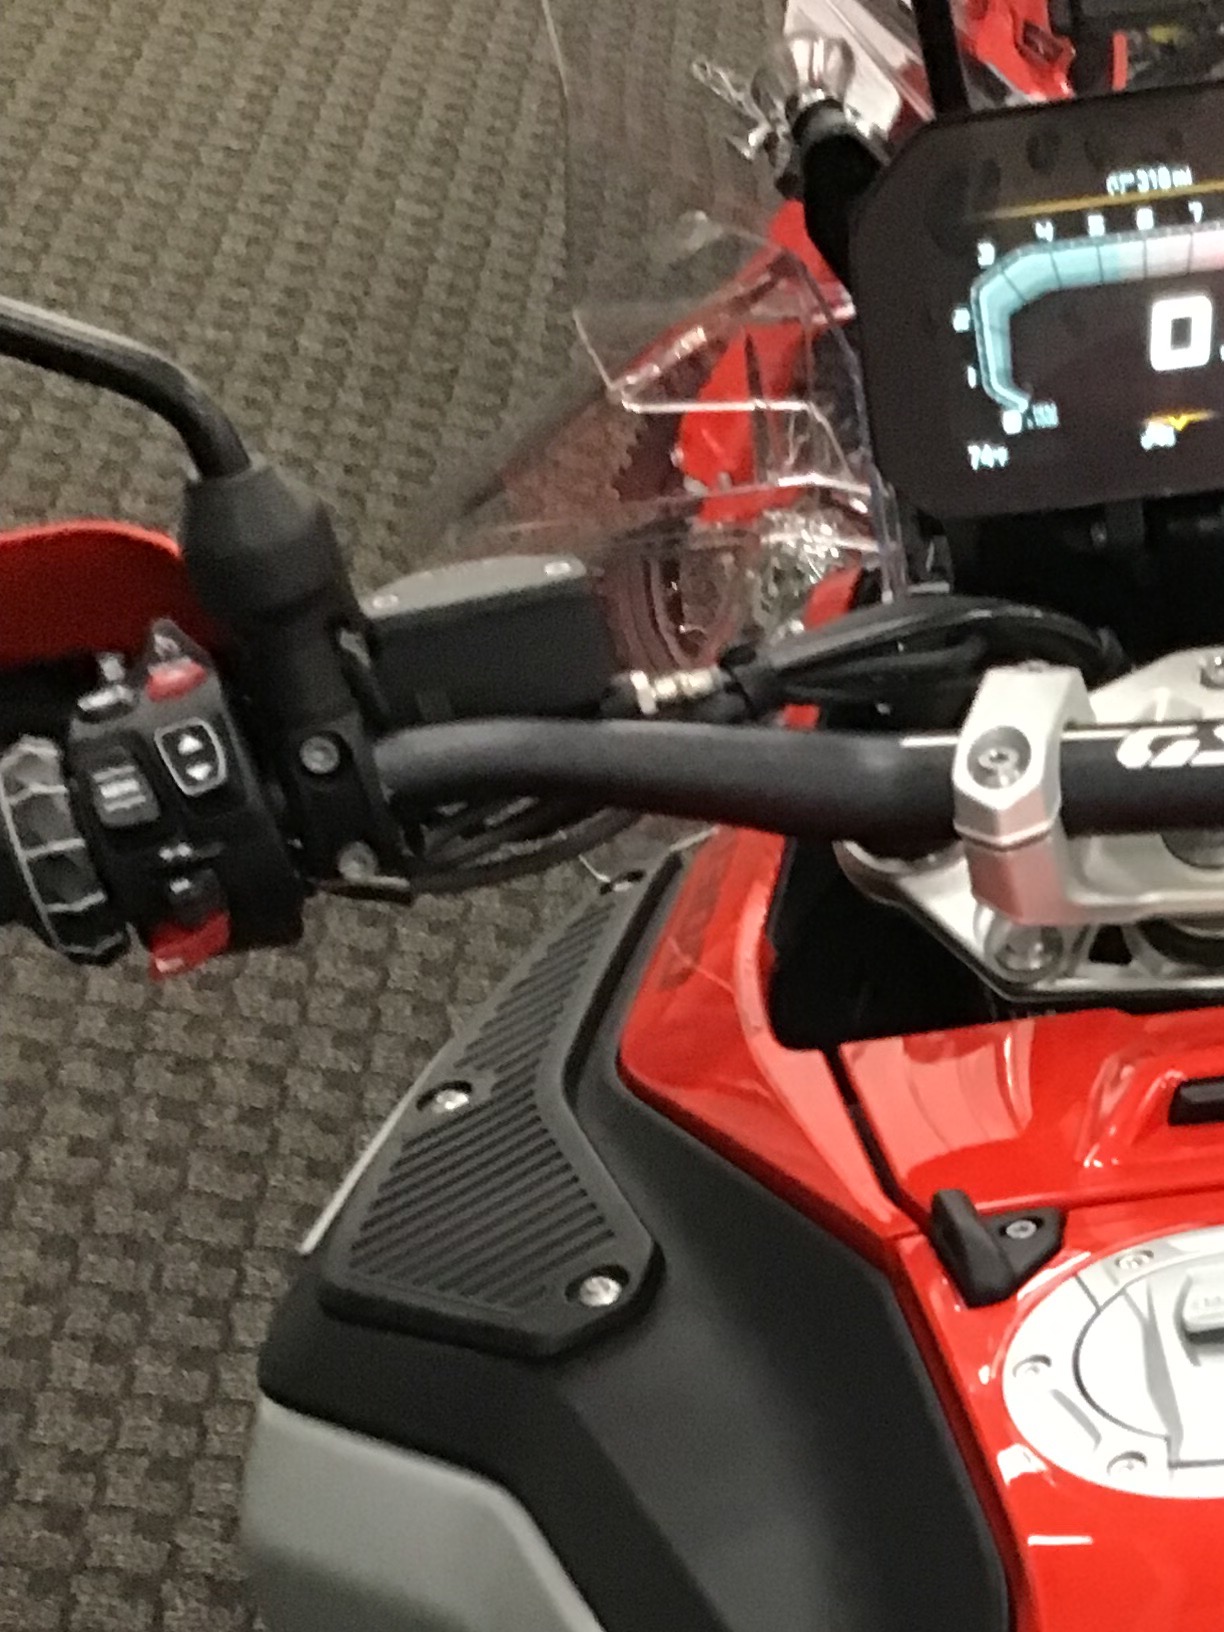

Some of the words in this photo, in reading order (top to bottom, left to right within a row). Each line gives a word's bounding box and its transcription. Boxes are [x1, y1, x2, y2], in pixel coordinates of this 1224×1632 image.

[1188, 201, 1203, 224] 7
[1034, 221, 1054, 243] 4
[977, 241, 996, 267] 3
[1150, 295, 1212, 372] 0
